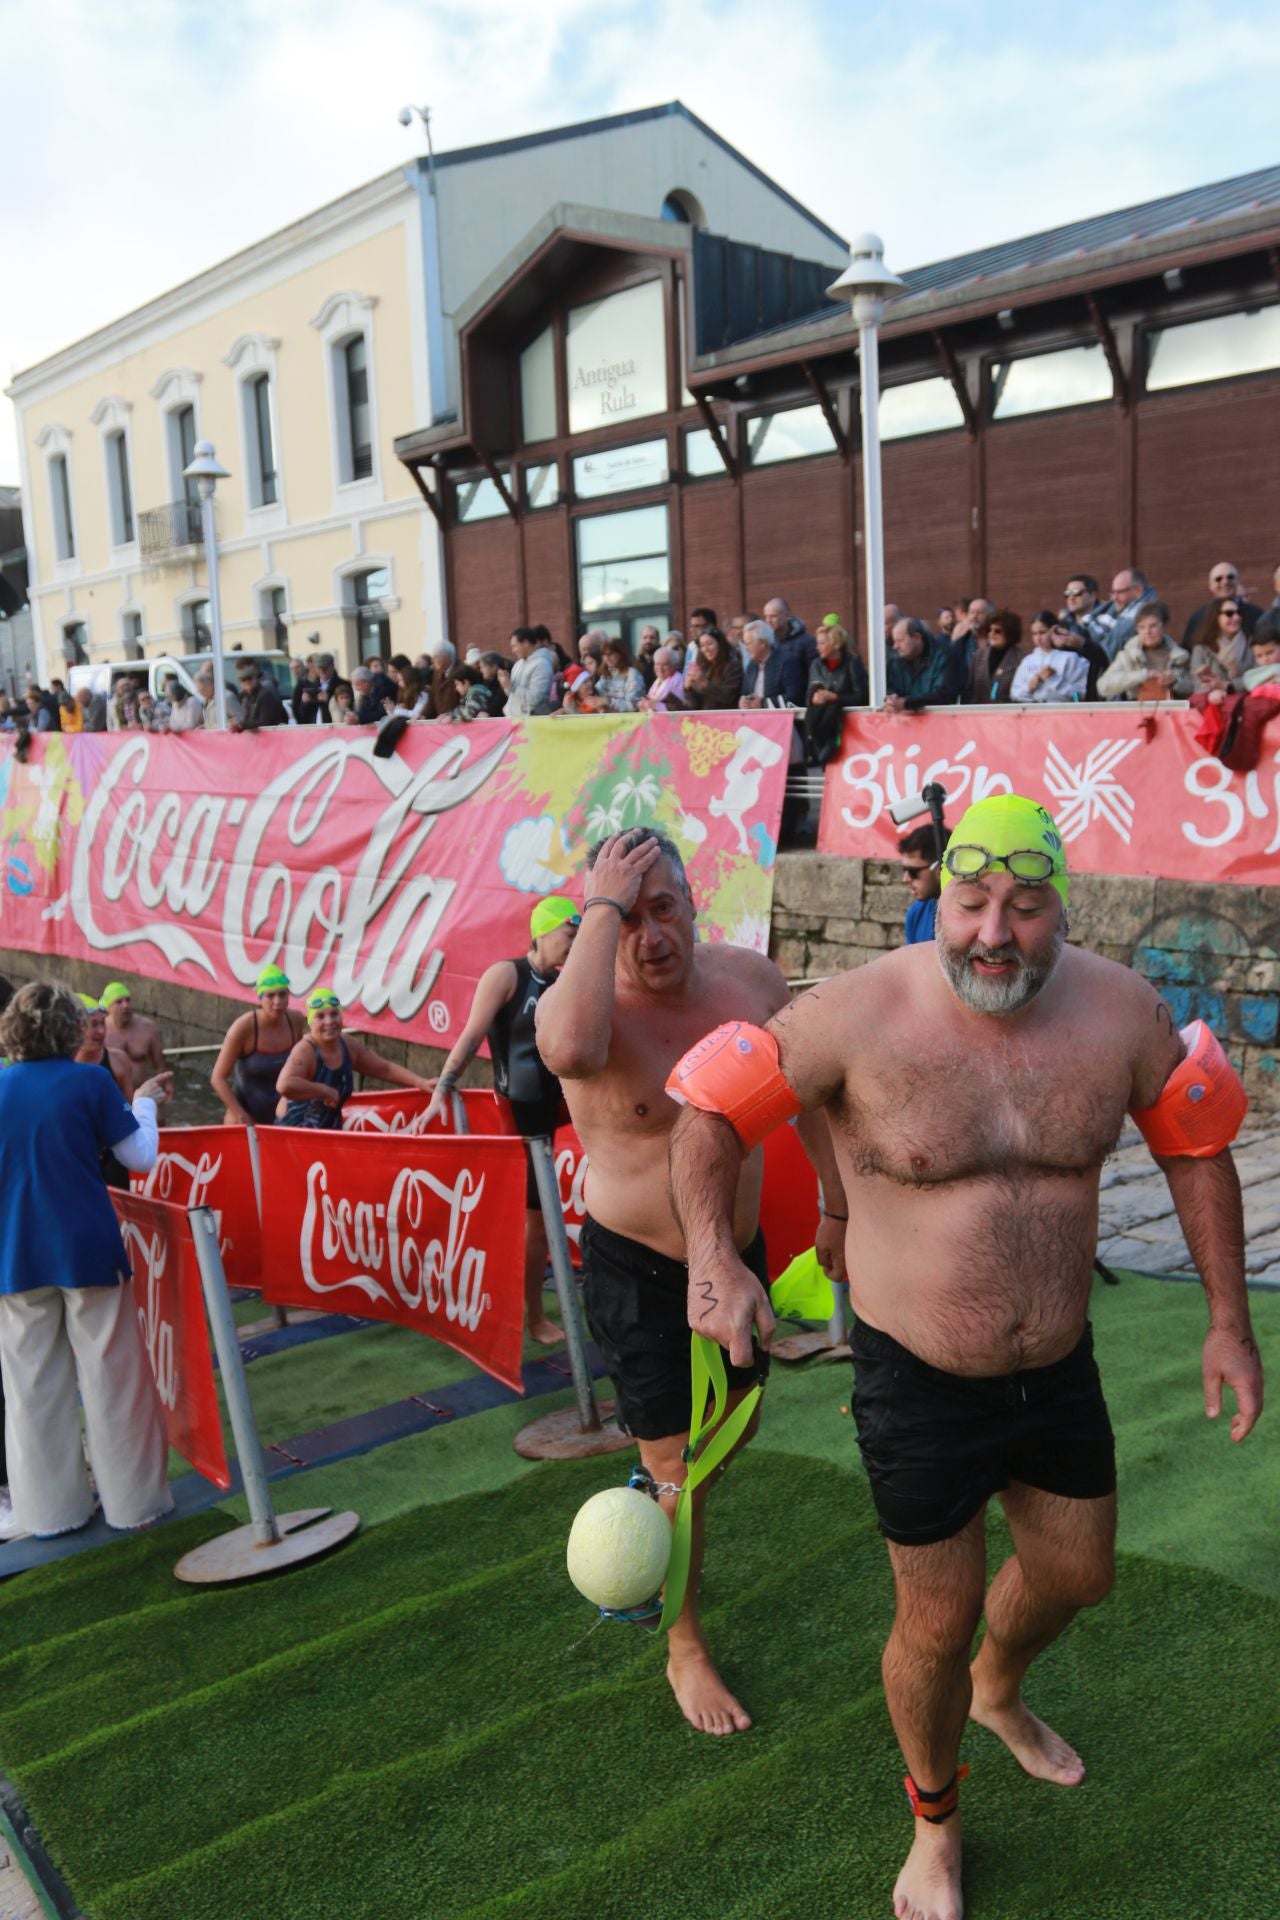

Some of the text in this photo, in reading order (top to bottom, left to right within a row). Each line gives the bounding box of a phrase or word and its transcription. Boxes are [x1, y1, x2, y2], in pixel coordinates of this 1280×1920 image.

[601, 384, 637, 415] Rula
[70, 735, 513, 1021] Coca-Cola
[682, 1029, 731, 1071] INTEX
[300, 1160, 487, 1333] Coca-Cola
